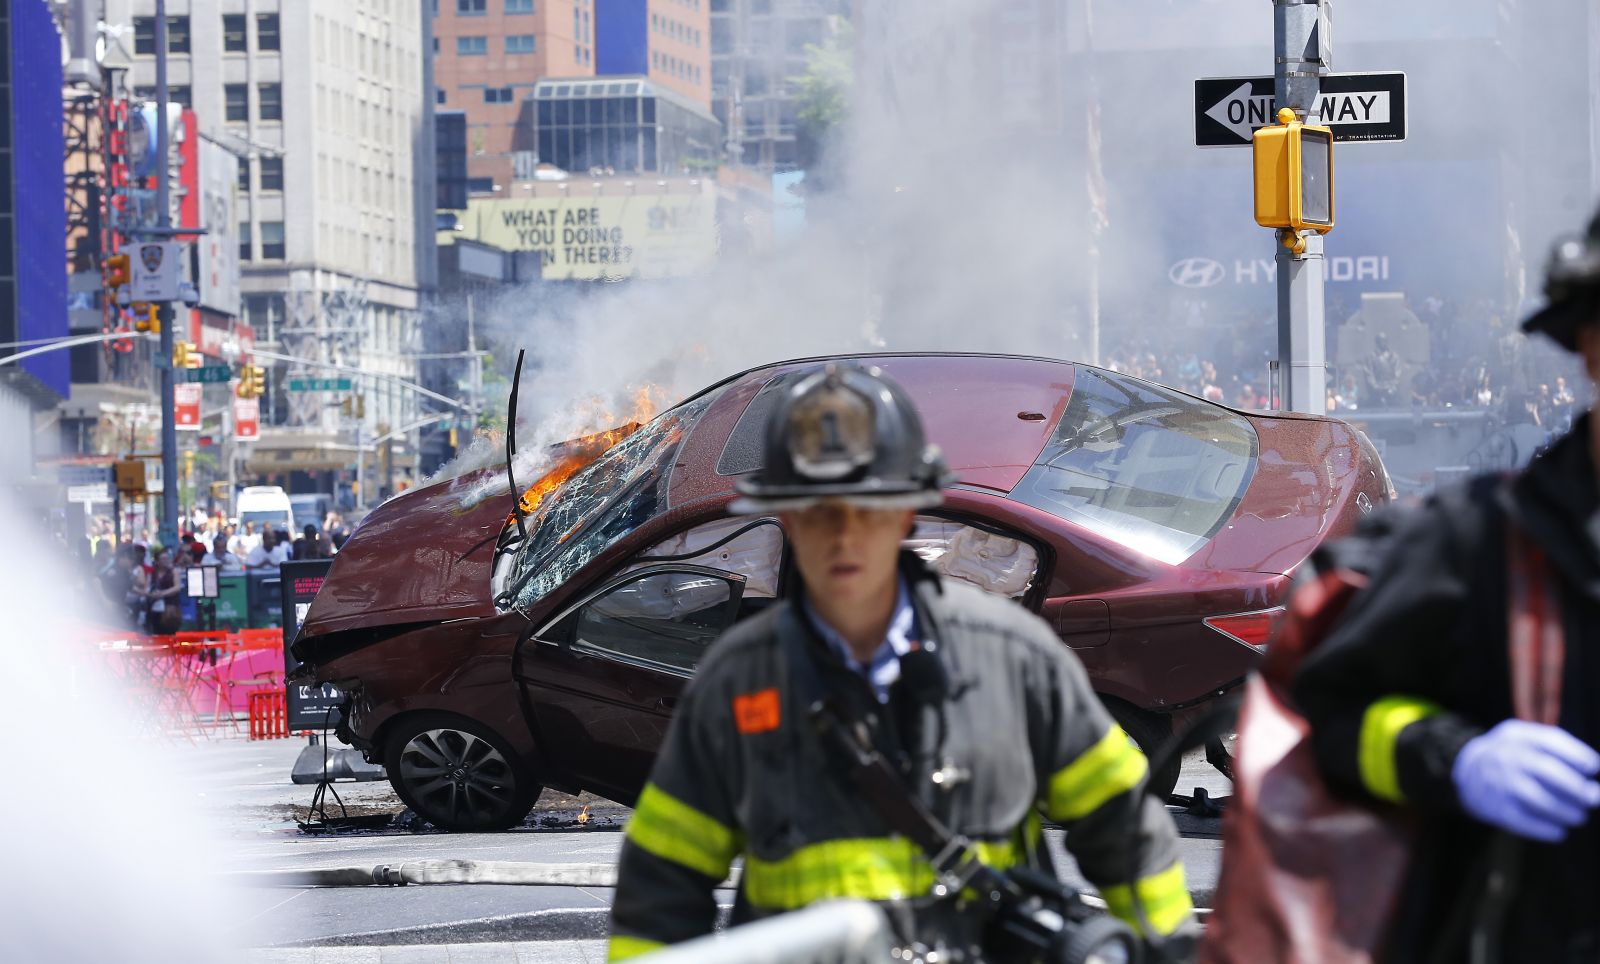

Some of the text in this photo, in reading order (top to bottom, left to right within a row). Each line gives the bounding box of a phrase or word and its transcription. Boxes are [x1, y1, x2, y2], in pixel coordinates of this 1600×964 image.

[1319, 95, 1377, 122] WAY
[502, 207, 599, 227] WHAT ARE
[516, 227, 623, 246] YOU DOING
[564, 245, 633, 264] THERE?
[1235, 256, 1389, 284] HYDAI
